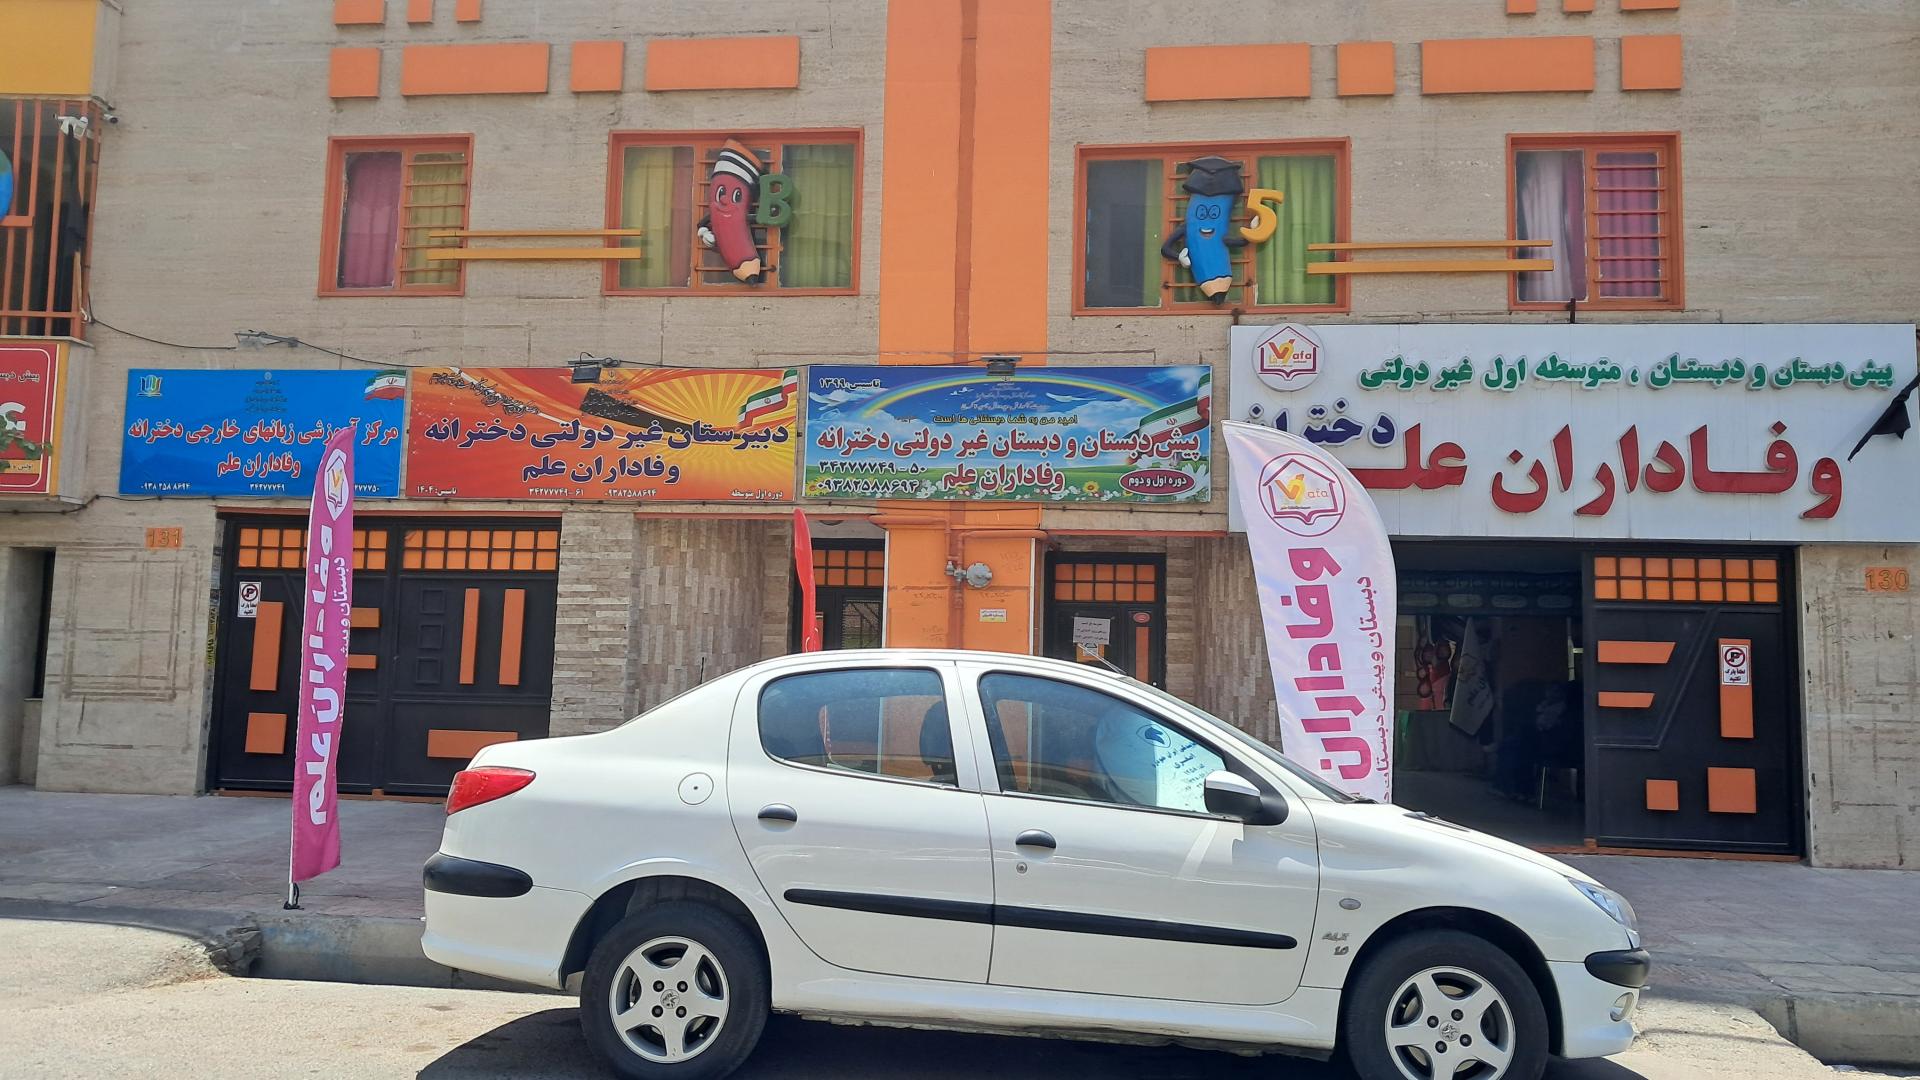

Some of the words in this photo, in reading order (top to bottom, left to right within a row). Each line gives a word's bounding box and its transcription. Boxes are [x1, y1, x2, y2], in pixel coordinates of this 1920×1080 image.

[756, 173, 795, 225] B
[1240, 189, 1283, 243] 5
[18, 370, 40, 382] پیش
[819, 377, 846, 389] ۱۳۹۹
[1359, 354, 1430, 390] دولتی
[1431, 357, 1475, 389] غیر
[1484, 354, 1527, 391] اول
[1535, 352, 1622, 389] متوسطه
[1650, 352, 1746, 388] دبستان
[1751, 363, 1766, 389] و
[1774, 357, 1844, 388] دبستان
[1849, 359, 1894, 389] پیش
[128, 418, 184, 444] دخترانه
[186, 418, 241, 444] خارجی
[243, 418, 296, 445] زبانهای
[361, 419, 399, 445] مرکز
[424, 417, 527, 449] دخترانه
[530, 417, 615, 449] دولتی
[618, 418, 664, 450] غیر
[667, 418, 790, 450] دبیرستان
[933, 414, 956, 424] است
[958, 414, 969, 424] ها
[1007, 413, 1027, 424] شما
[1028, 414, 1039, 425] به
[1040, 415, 1056, 425] من
[1058, 414, 1078, 425] امید
[815, 427, 892, 458] دخترانه
[893, 426, 954, 457] دولتی
[956, 426, 989, 457] غیر
[994, 427, 1062, 458] دبستان
[1064, 434, 1078, 460] و
[1078, 428, 1156, 461] دبستان
[1152, 427, 1201, 461] پیش
[1347, 422, 1469, 490] عل
[216, 452, 242, 478] علم
[243, 453, 302, 478] وفاداران
[522, 454, 568, 483] علم
[569, 454, 681, 485] وفاداران
[818, 460, 897, 475] ۳۴۲۷۷۷۴۹
[942, 462, 978, 490] علم
[980, 462, 1066, 493] وفاداران
[1152, 474, 1167, 487] اول
[1492, 420, 1843, 520] وفاداران
[1128, 477, 1144, 488] دوم
[1145, 477, 1151, 487] و
[1168, 477, 1187, 487] دوره
[332, 556, 351, 616] دبستان
[1865, 568, 1910, 591] 130
[308, 524, 340, 724] وفاداران
[1357, 575, 1384, 650] دبستان
[1280, 547, 1373, 780] وفاداران
[1371, 650, 1385, 666] و
[1371, 665, 1387, 711] پیش
[1375, 713, 1391, 788] دبستان
[304, 732, 332, 825] علم
